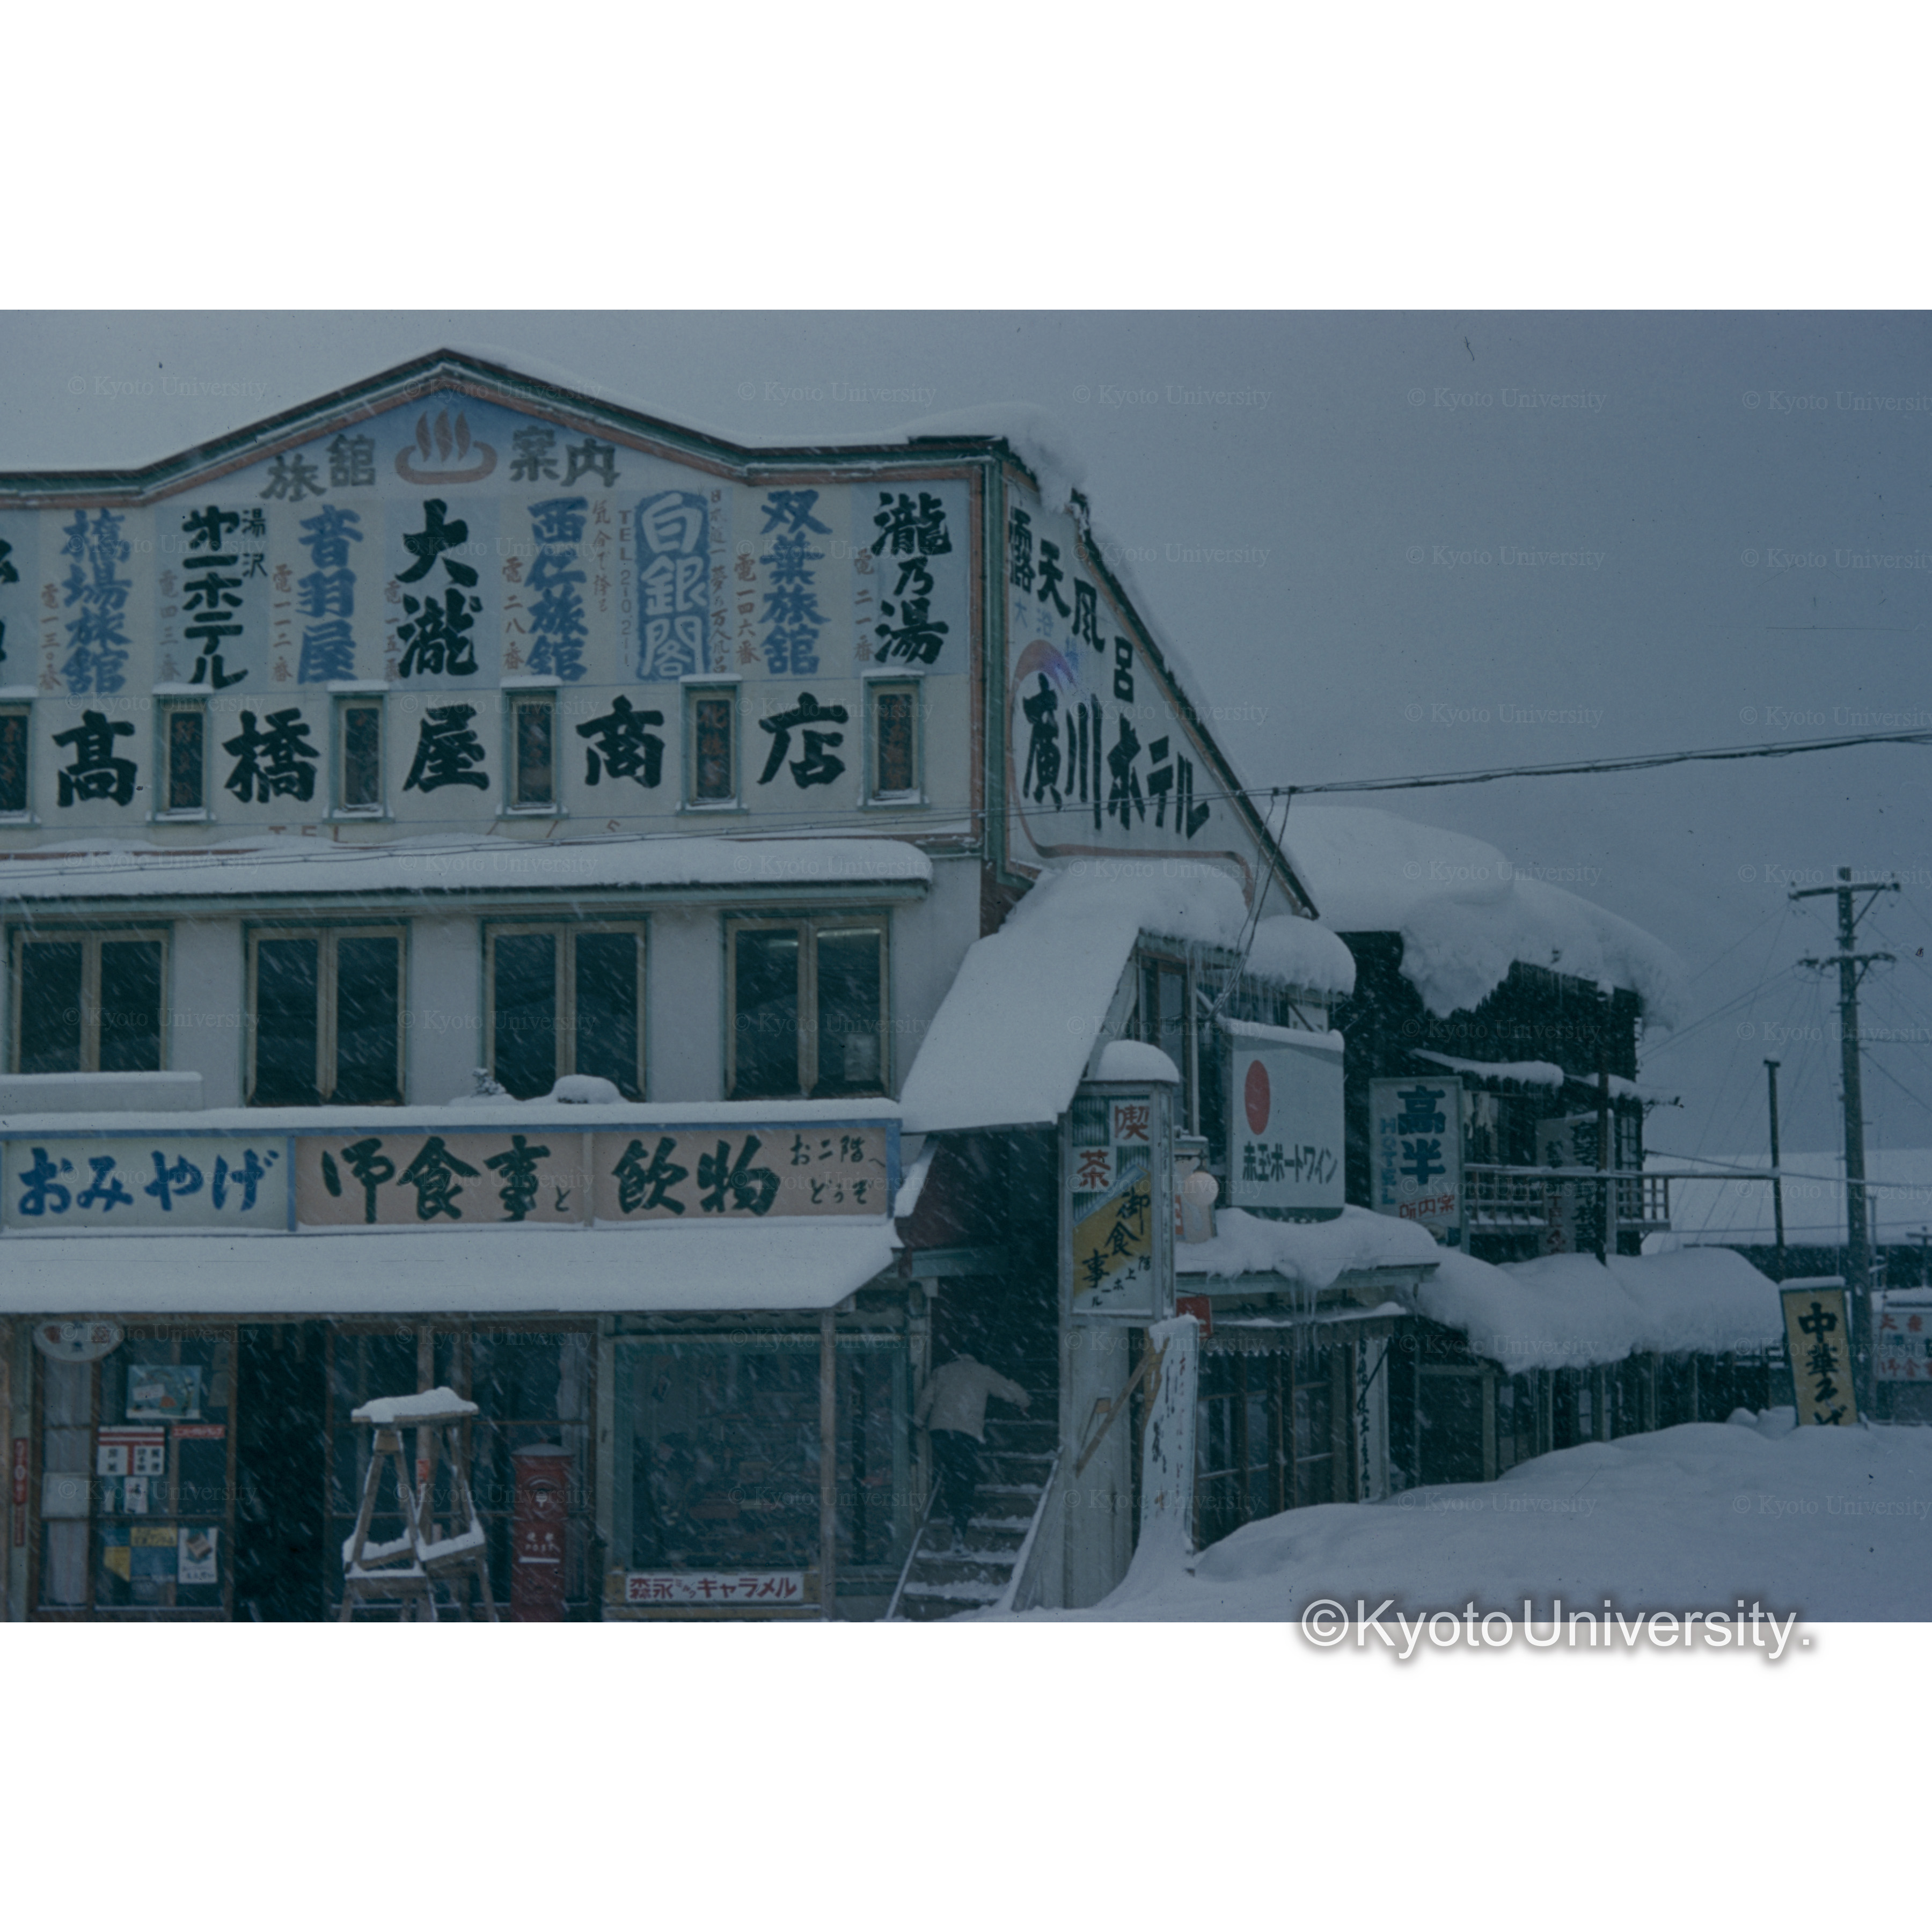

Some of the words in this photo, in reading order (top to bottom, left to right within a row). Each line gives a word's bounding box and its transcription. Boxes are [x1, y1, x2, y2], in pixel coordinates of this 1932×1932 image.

[260, 434, 376, 502] 旅館
[510, 425, 620, 487] 案内
[241, 508, 267, 577] 湯沢
[618, 510, 632, 561] TEL
[295, 504, 363, 684] 音羽屋
[395, 498, 482, 678] 大瀧
[502, 556, 525, 670] 電二八番
[639, 491, 707, 678] 白銀閣
[734, 553, 761, 665] 電一四六番
[758, 489, 833, 675] 双葉旅館
[1008, 505, 1135, 704] 露天風呂
[611, 1135, 781, 1217] 飲物
[790, 1133, 887, 1166] お二階へ
[1077, 1104, 1150, 1189] 喫茶
[1380, 1117, 1397, 1205] HOTEL
[1397, 1085, 1447, 1185] 高半
[18, 1146, 280, 1217] おみやげ
[811, 1177, 868, 1205] どうぞ
[1082, 1187, 1151, 1289] 御食事
[630, 1577, 797, 1599] 森永ミルクキャラメル
